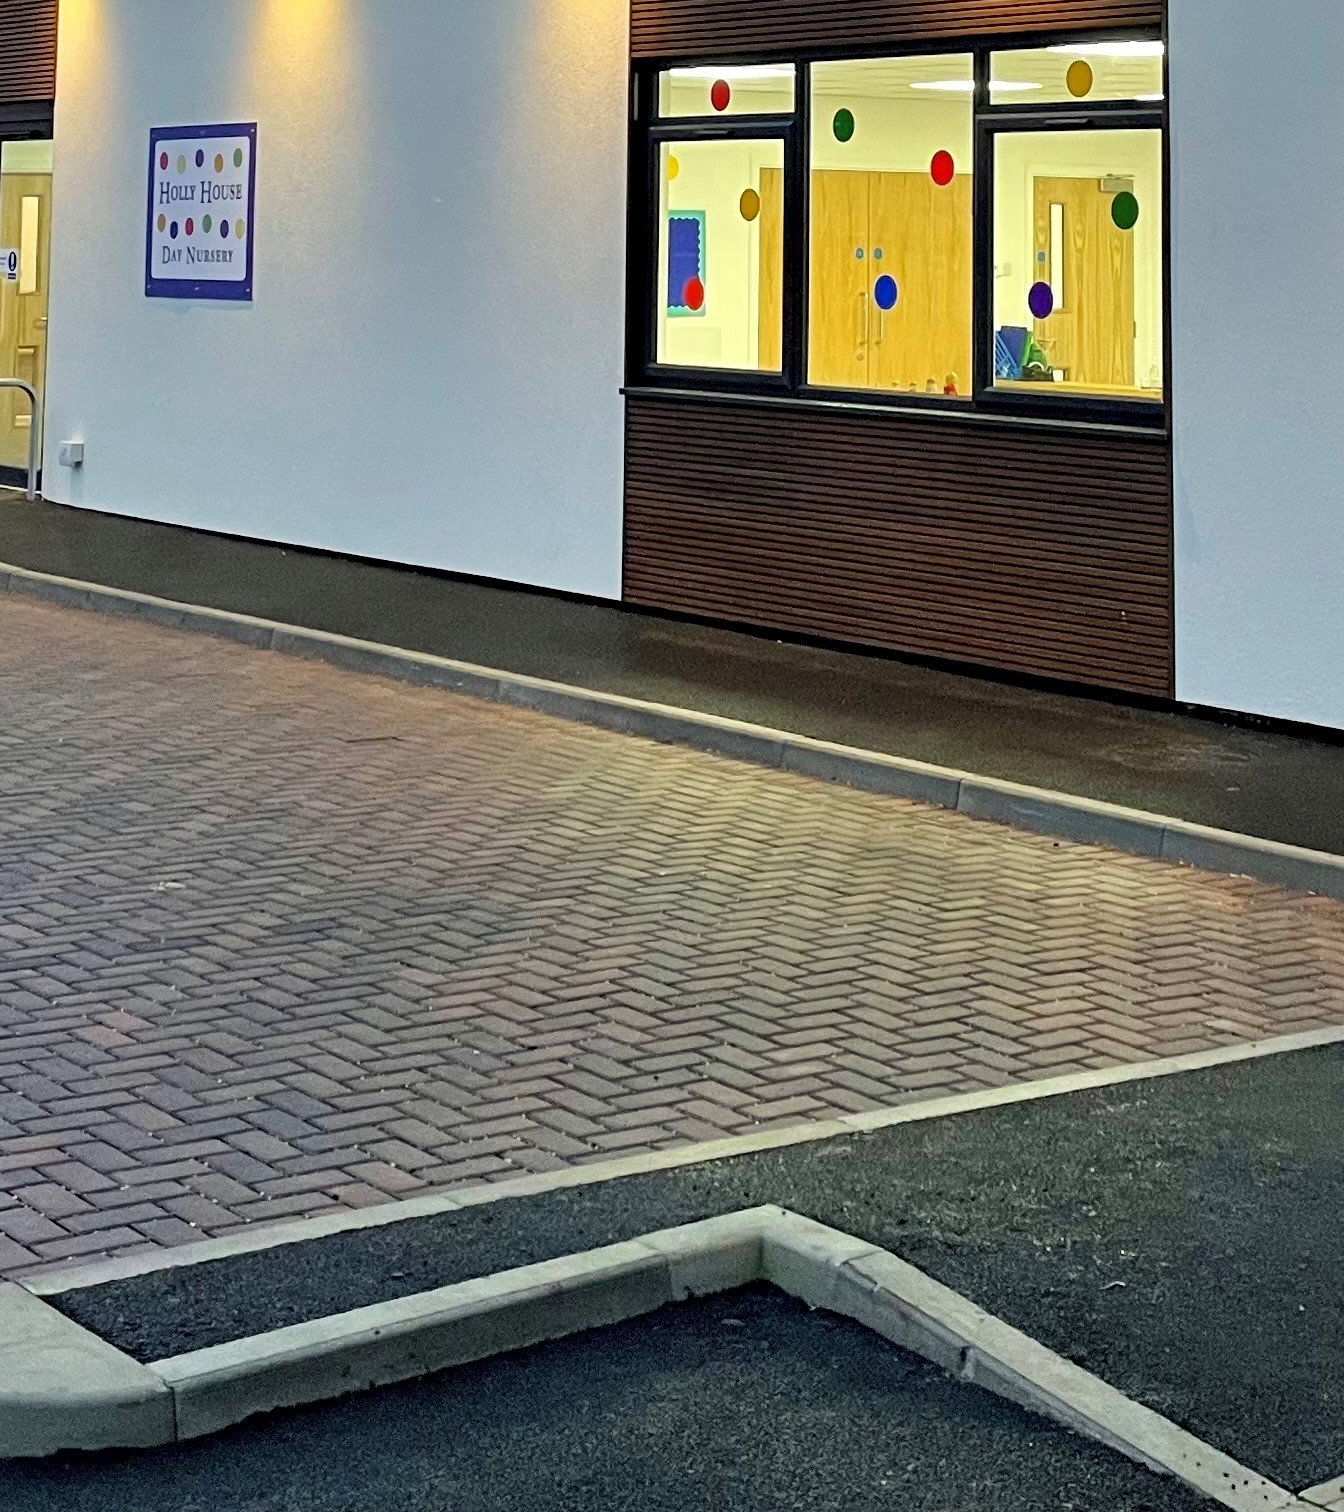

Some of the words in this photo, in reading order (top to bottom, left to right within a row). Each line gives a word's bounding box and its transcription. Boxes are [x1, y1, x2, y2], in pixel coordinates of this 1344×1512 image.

[159, 181, 196, 204] HOLLY
[200, 180, 242, 204] HOUSE
[162, 245, 182, 264] DAY
[186, 245, 234, 265] NURSERY
